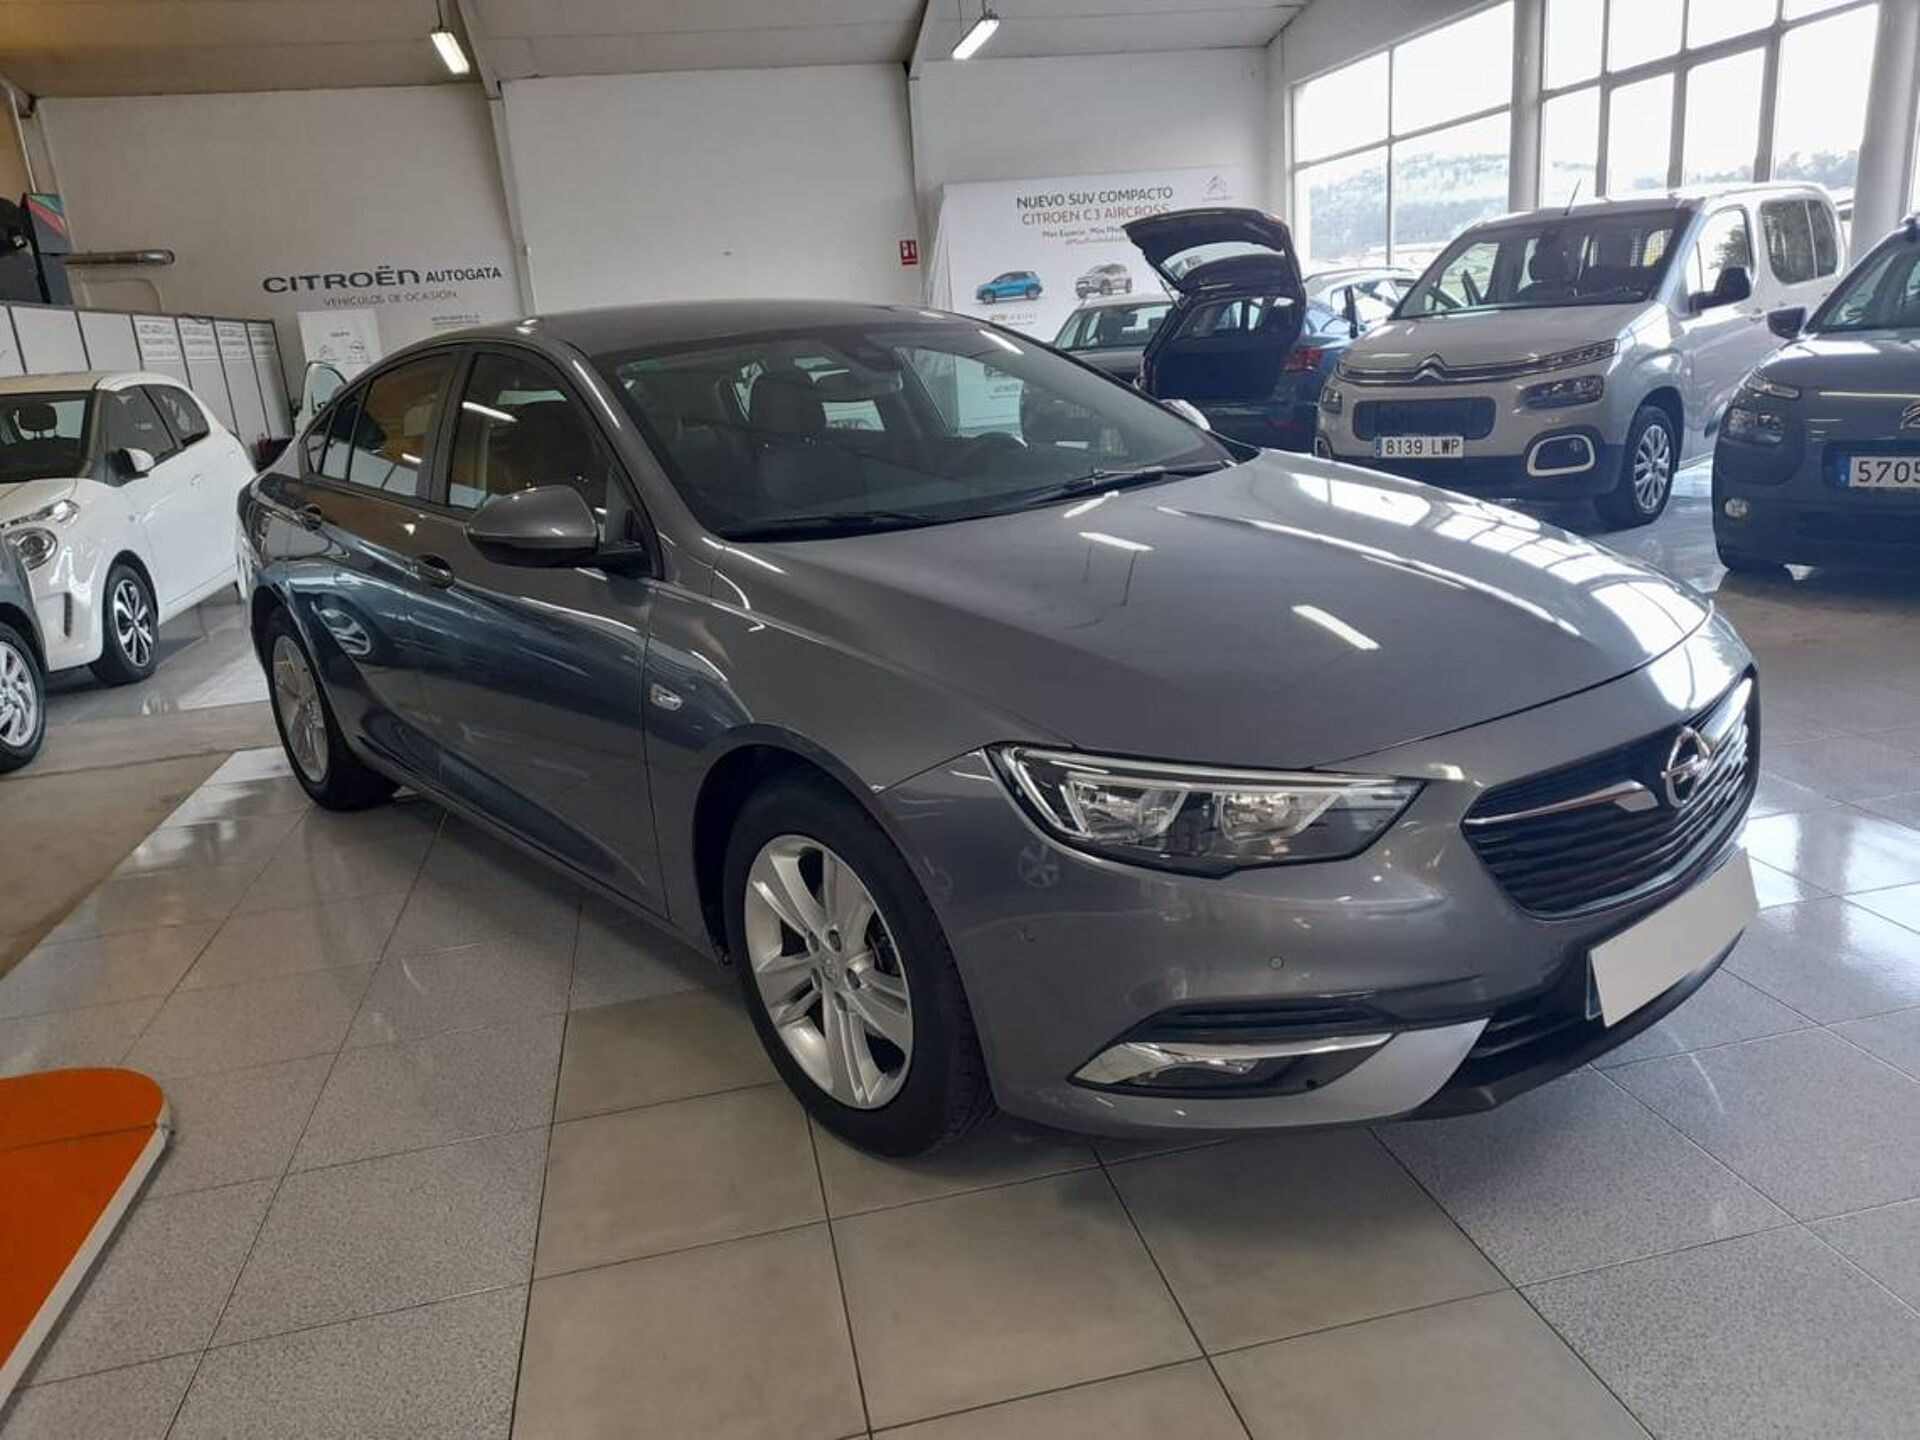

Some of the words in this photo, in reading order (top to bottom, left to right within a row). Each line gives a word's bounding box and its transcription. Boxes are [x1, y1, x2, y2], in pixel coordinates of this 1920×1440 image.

[1017, 193, 1065, 209] NUEVO
[1068, 191, 1095, 206] SUV
[1099, 186, 1173, 203] COMPACTO
[1104, 203, 1170, 219] AIRCROSS
[425, 266, 502, 283] AUTOGATA
[1386, 439, 1423, 455] 8139
[1431, 439, 1459, 455] LWP
